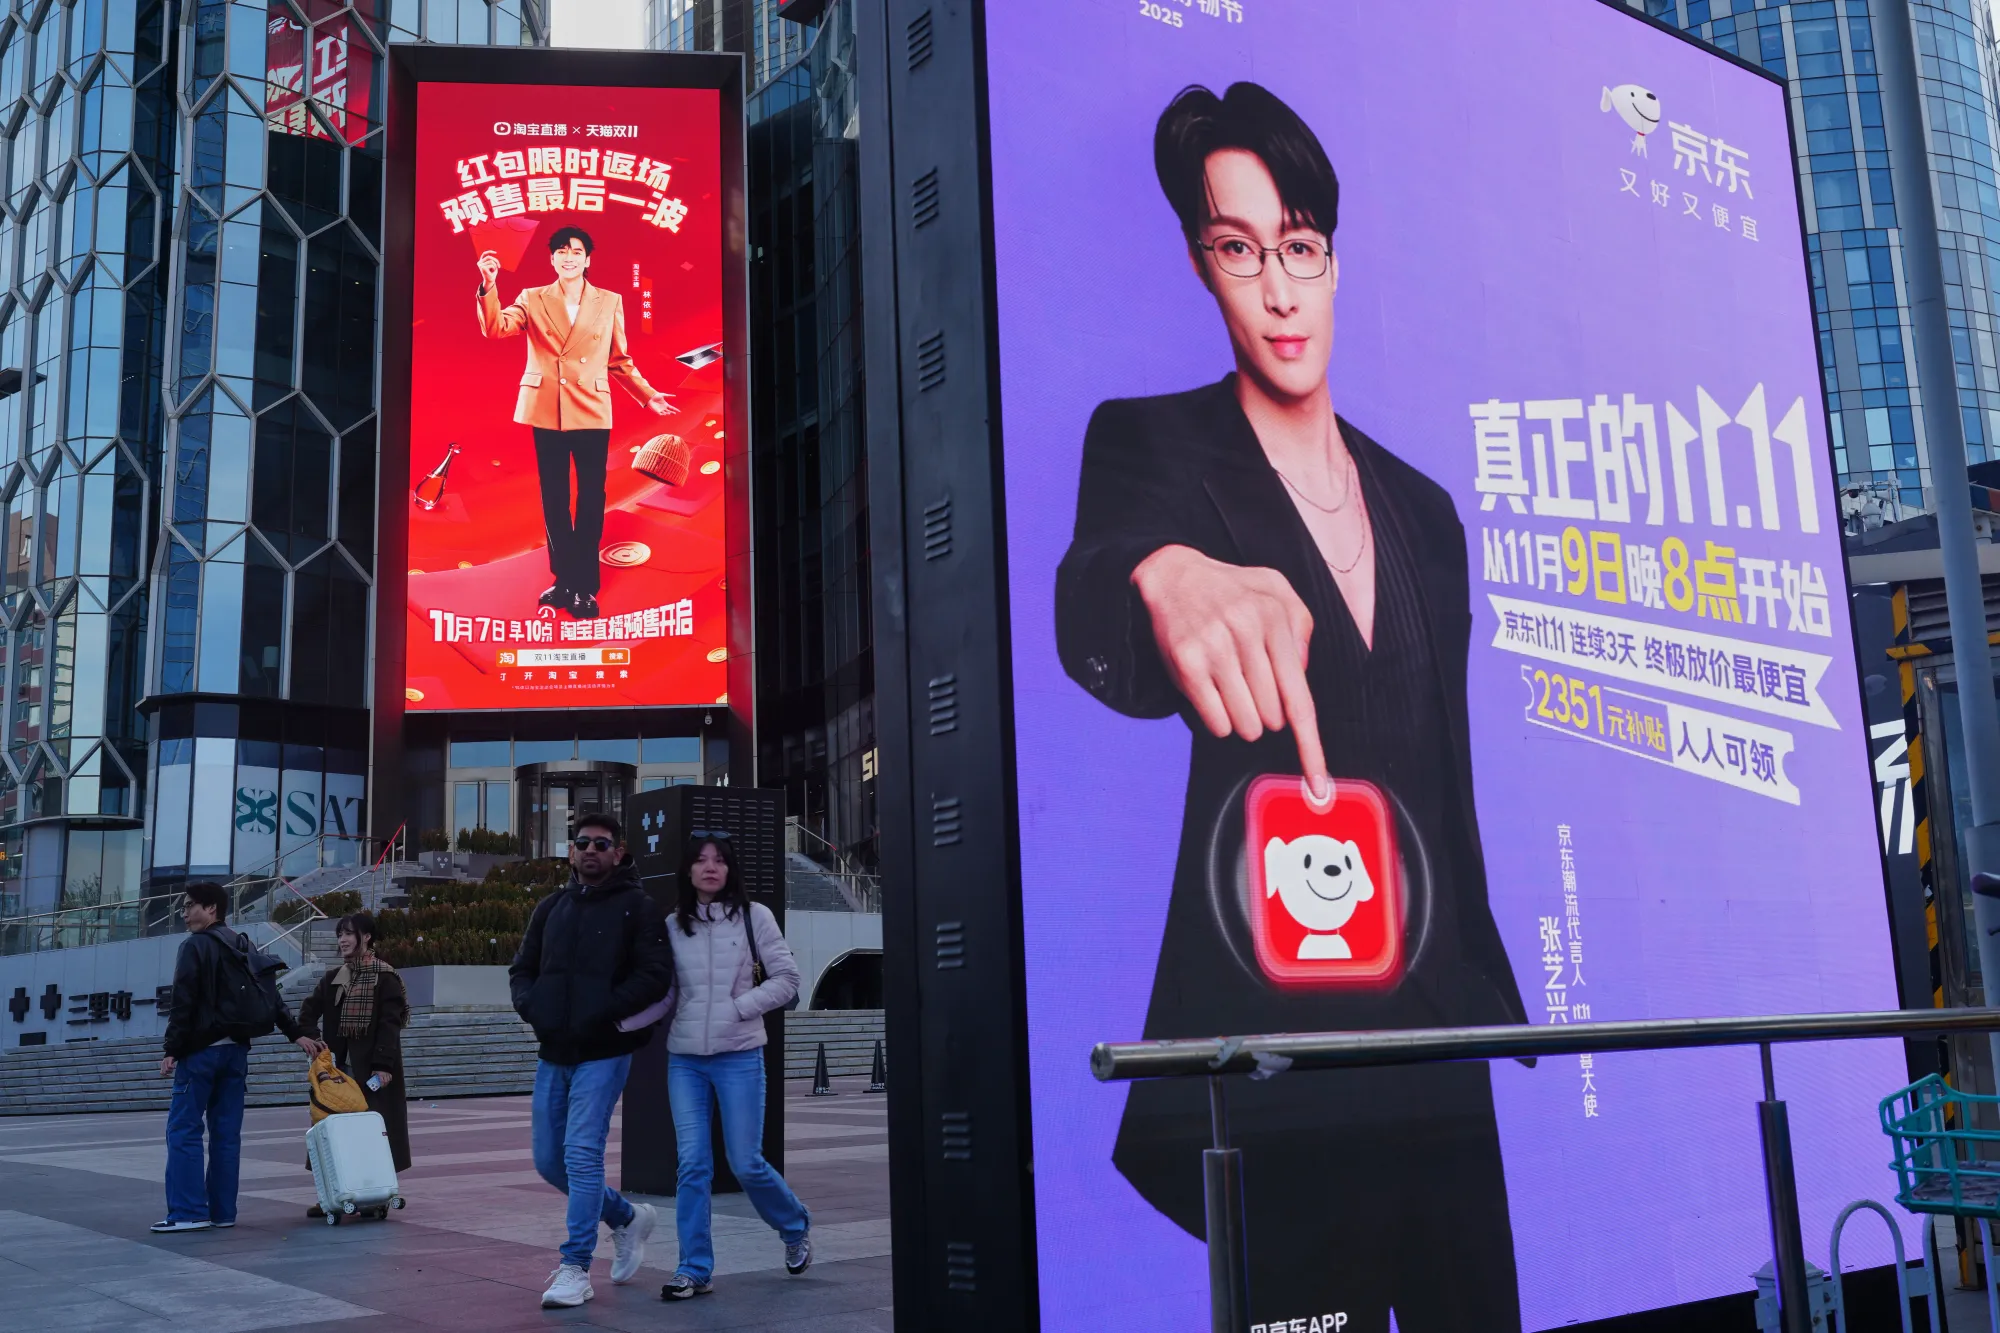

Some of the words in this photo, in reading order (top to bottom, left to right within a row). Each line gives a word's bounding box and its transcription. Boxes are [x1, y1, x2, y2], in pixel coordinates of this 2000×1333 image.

[1139, 0, 1184, 28] 2025
[513, 122, 567, 137] 淘宝直播
[586, 124, 639, 138] 天猫双11
[456, 147, 673, 192] 红包限时返场
[1668, 120, 1753, 200] 京东
[440, 178, 688, 234] 预售最后一波
[1620, 167, 1759, 242] 又好又便宜
[643, 291, 652, 319] 林依轮
[1482, 526, 1833, 637] 从11月9日晚8点开始
[560, 598, 693, 641] 淘宝直播预售开启
[499, 652, 515, 664] 淘
[534, 652, 586, 662] 双11淘宝直播
[609, 652, 624, 661] 搜索
[1570, 622, 1638, 668] 连续3天
[1644, 636, 1811, 707] 终极放价最便宜
[1533, 669, 1666, 753] 2351元补贴
[1677, 721, 1778, 786] 人人可领
[1557, 824, 1586, 987] 京东潮流代言人
[1539, 916, 1569, 1024] 张艺兴
